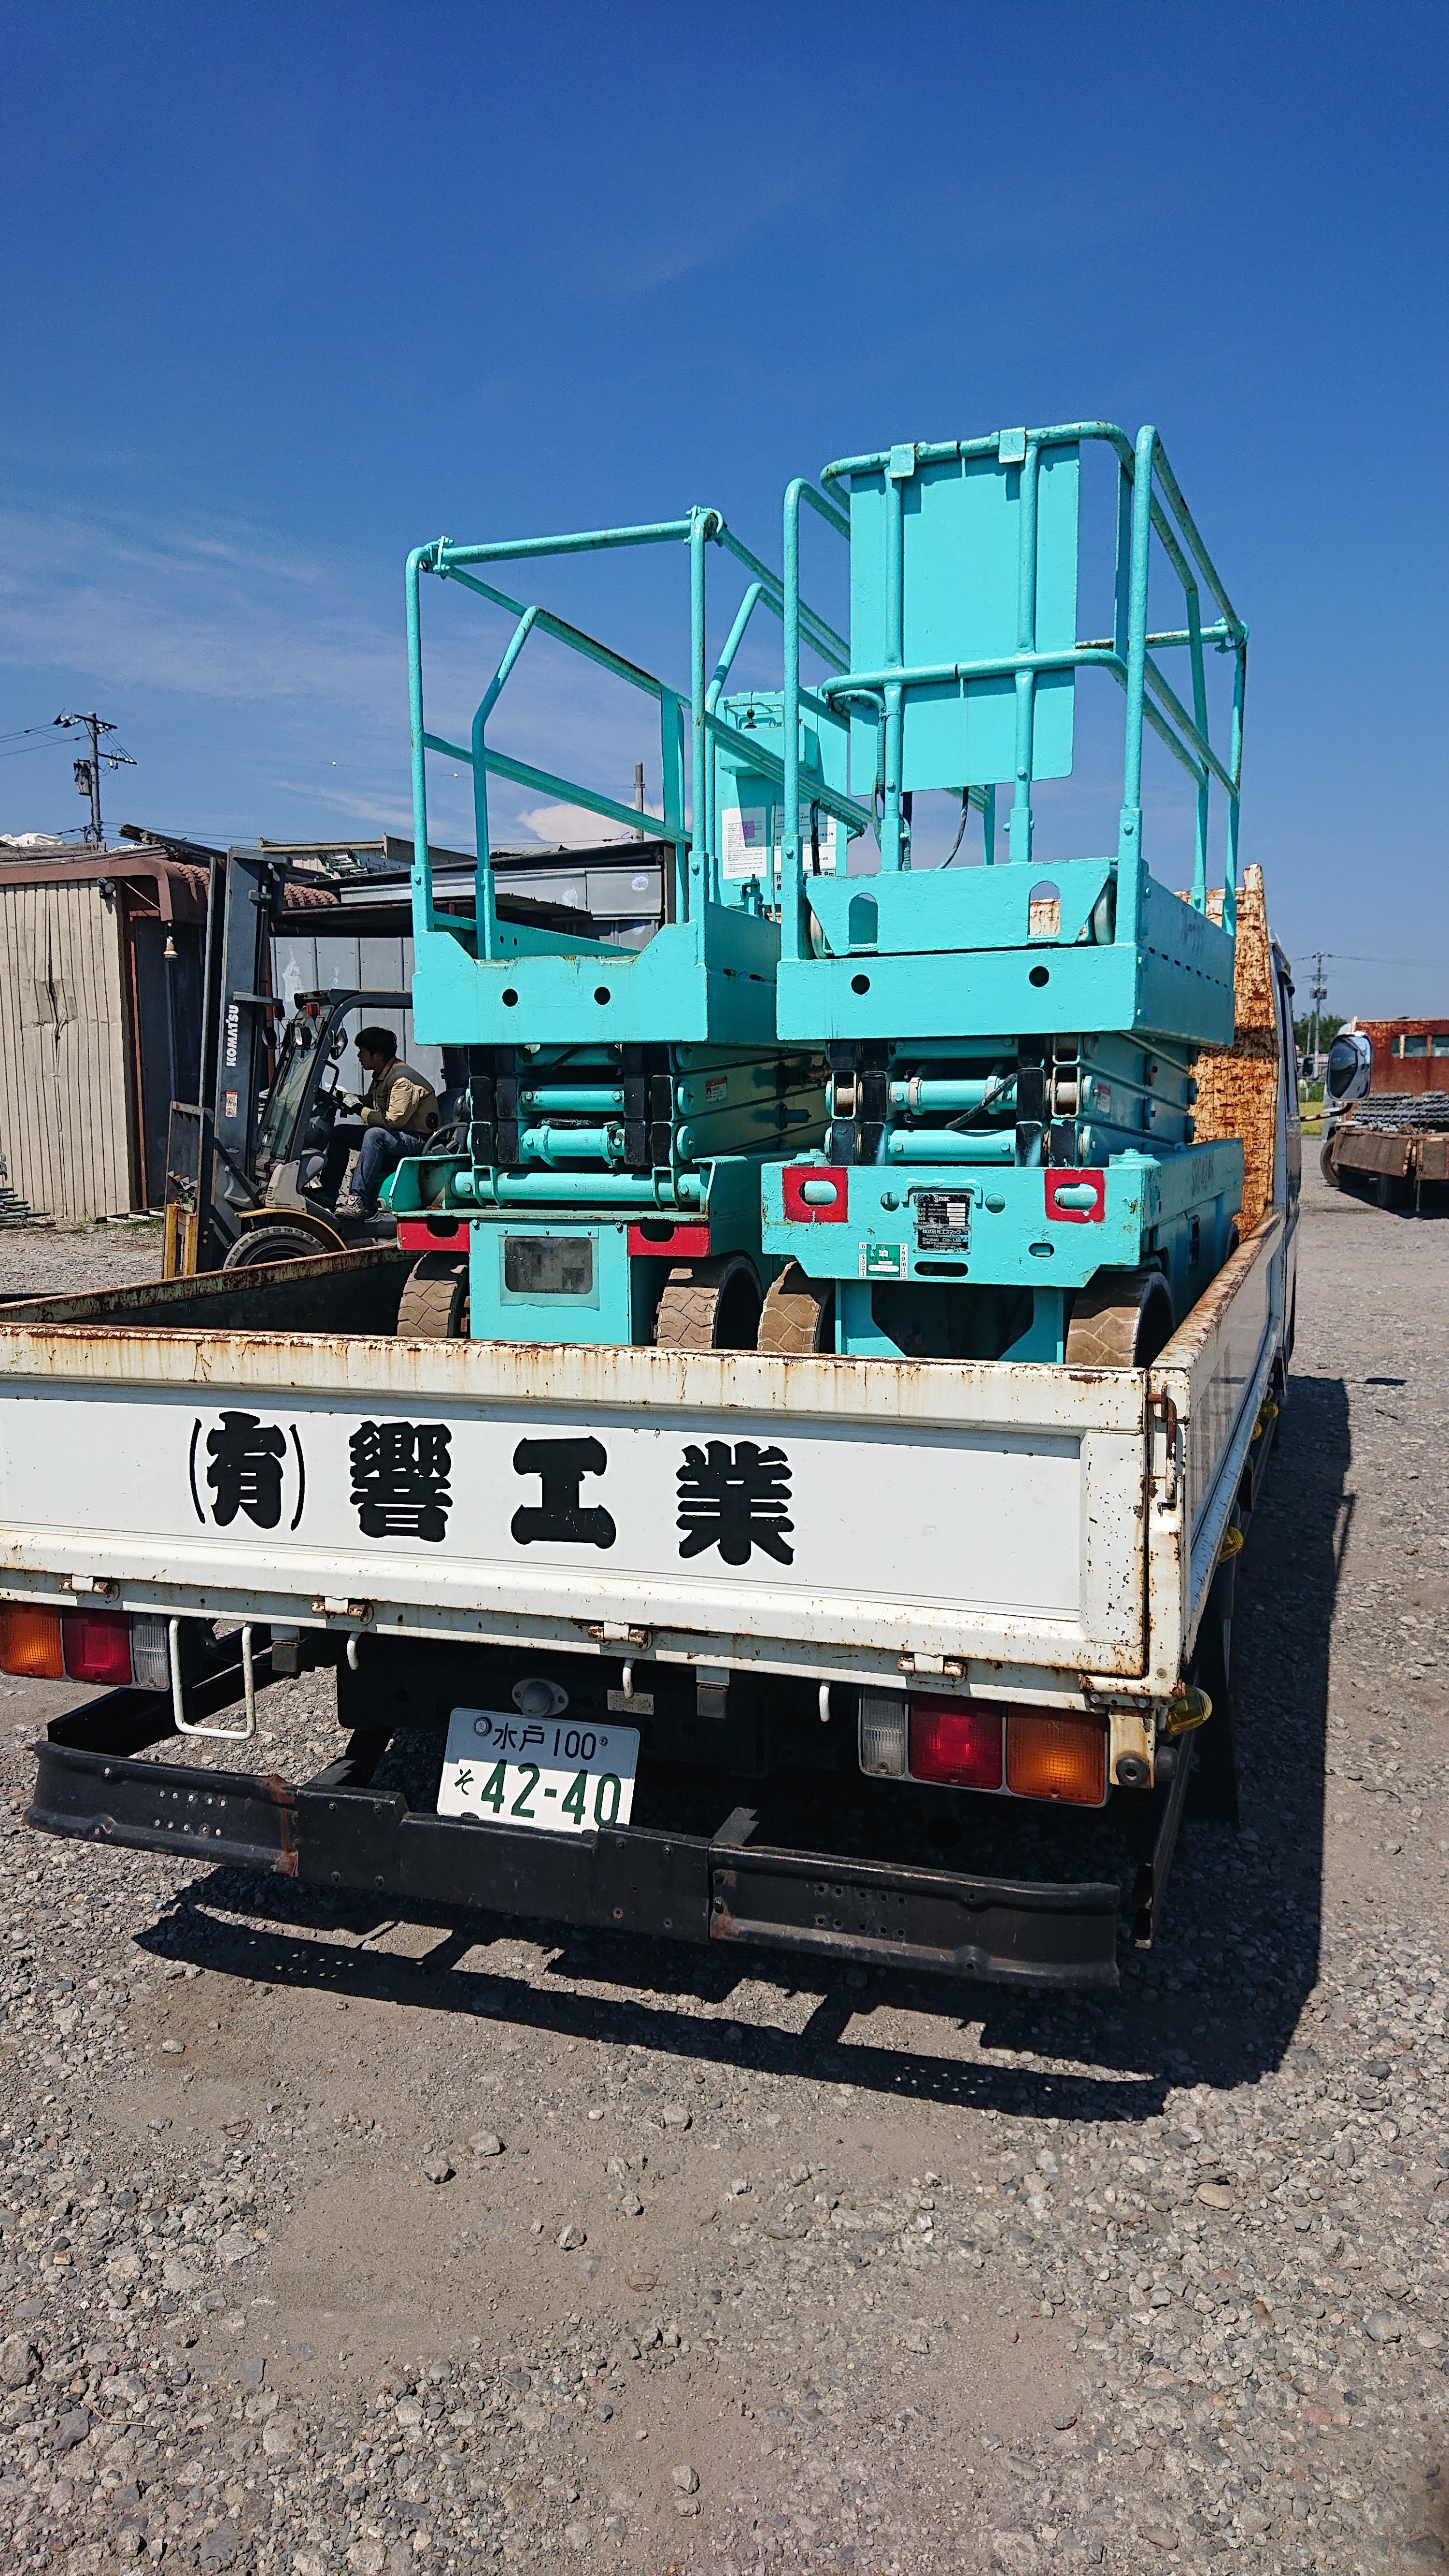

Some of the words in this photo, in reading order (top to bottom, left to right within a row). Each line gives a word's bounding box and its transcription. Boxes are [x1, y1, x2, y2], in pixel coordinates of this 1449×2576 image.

[226, 1004, 239, 1067] KOMATSU
[454, 1768, 474, 1795] そ
[481, 1758, 622, 1826] 42-40
